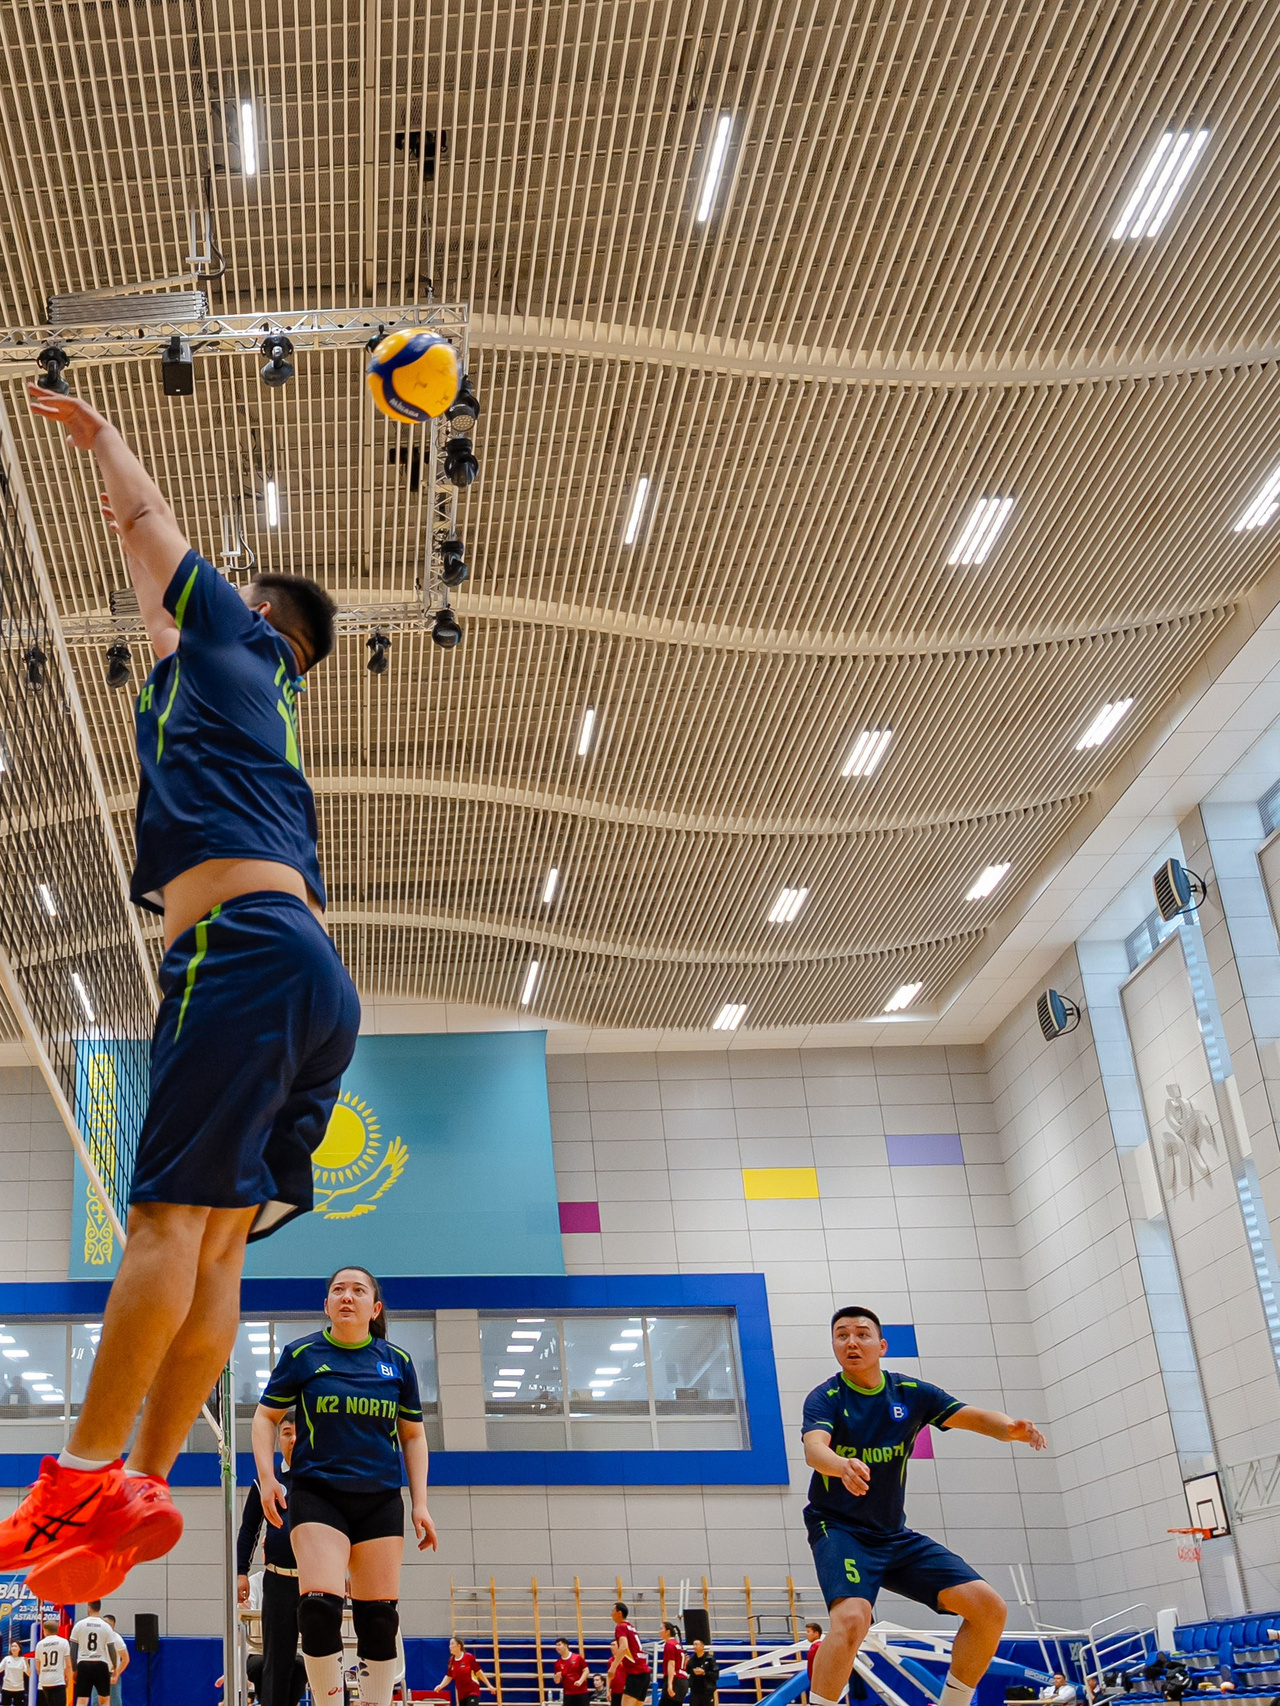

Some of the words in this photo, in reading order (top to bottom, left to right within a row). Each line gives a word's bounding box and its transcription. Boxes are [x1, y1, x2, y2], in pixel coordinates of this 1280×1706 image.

[381, 1365, 394, 1377] BI
[316, 1396, 339, 1413] K2
[346, 1396, 397, 1419] NORTH
[844, 1558, 861, 1584] 5
[13, 1613, 42, 1621] ASTANA
[87, 1632, 98, 1652] 8
